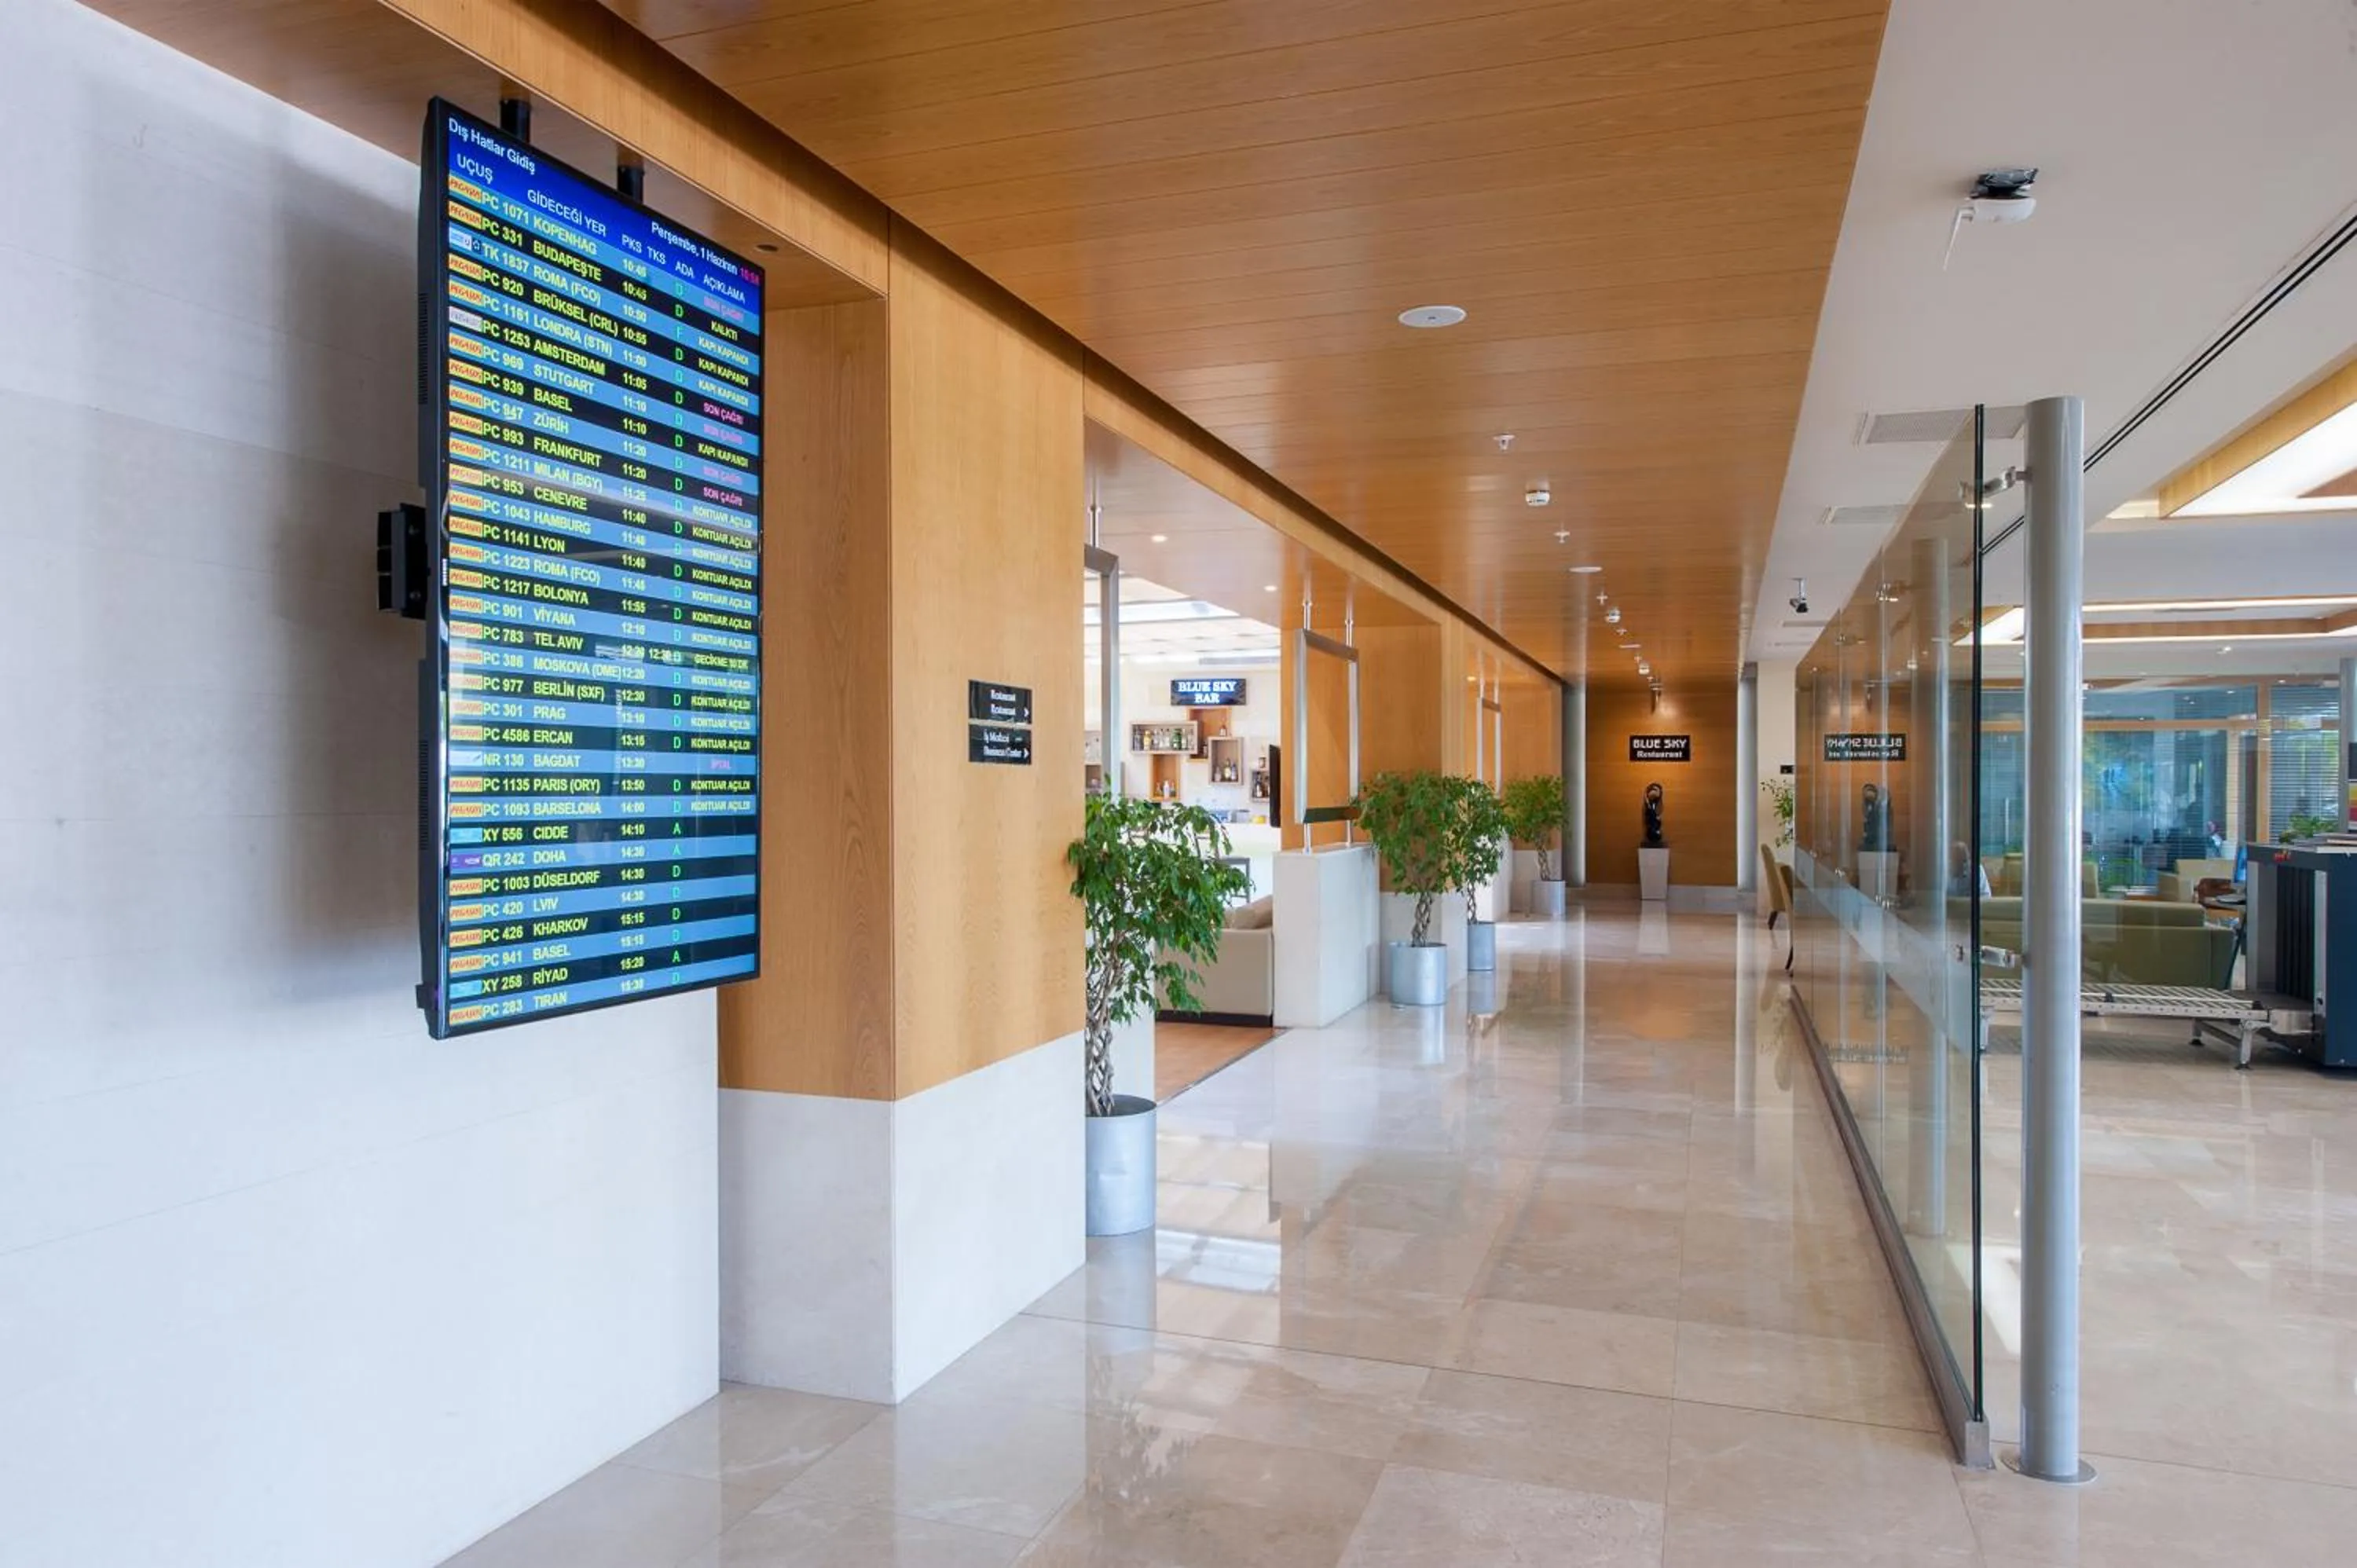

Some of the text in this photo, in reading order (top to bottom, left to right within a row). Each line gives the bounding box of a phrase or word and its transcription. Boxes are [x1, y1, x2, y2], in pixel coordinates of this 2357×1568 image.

[449, 117, 535, 177] Dış Hatlar Gidiş
[456, 152, 493, 185] UÇUŞ
[527, 185, 582, 226] GİDECEĞİ
[584, 214, 606, 237] YER
[621, 233, 642, 254] PKS
[647, 245, 666, 266] TKS
[675, 258, 694, 279] ADA
[703, 272, 745, 306] AÇIKLAMA
[482, 190, 499, 211] PC
[533, 214, 596, 255] KOPENHAG
[482, 216, 498, 236] PC
[502, 225, 522, 246] 331
[533, 239, 601, 283] BUDAPEŞTE
[482, 242, 498, 262] TK
[533, 264, 567, 291] ROMA
[706, 248, 738, 277] Haziran
[483, 268, 498, 287] PC
[502, 276, 523, 297] 920
[533, 285, 587, 322] BRÜKSEL
[589, 311, 618, 336] (CRL)
[483, 294, 498, 312] PC
[533, 313, 581, 343] LONDRA
[483, 319, 500, 338] PC
[504, 327, 530, 349] 1253
[533, 338, 604, 376] AMSTERDAM
[622, 371, 646, 390] 11:05
[484, 345, 500, 363] PC
[533, 362, 593, 394] STUTGART
[484, 371, 646, 435] PC 939 BASEL 11:10
[484, 396, 500, 413] PC
[484, 421, 500, 438] PC
[503, 427, 523, 445] 993
[534, 436, 601, 467] FRANKFURT
[622, 462, 646, 479] 11:20
[484, 447, 500, 463] PC
[504, 452, 529, 471] 1211
[483, 498, 500, 515] PC
[484, 472, 500, 489] PC
[533, 485, 587, 510] CENEVRE
[622, 507, 646, 524] 11:40
[483, 524, 564, 552] PC 1141 LYON
[483, 549, 499, 565] PC
[533, 559, 567, 577] ROMA
[483, 575, 499, 590] PC
[503, 578, 530, 595] 1217
[533, 583, 588, 604] BOLONYA
[483, 600, 499, 615] PC
[483, 625, 583, 650] PC 783 TEL AVIV
[483, 651, 499, 665] PC
[533, 657, 589, 674] MOSKOVA
[483, 676, 499, 691] PC
[503, 678, 523, 692] 977
[533, 678, 574, 696] BERLİN
[577, 684, 604, 701] (SXF)
[1178, 681, 1237, 691] BLUE SKY
[1194, 693, 1219, 703] BAR
[483, 702, 499, 716] PC
[533, 705, 566, 720] PRAG
[483, 727, 499, 740] PC
[533, 729, 572, 743] ERCAN
[1633, 738, 1688, 749] BLUE SKY
[483, 753, 500, 765] NR
[483, 778, 499, 790] PC
[503, 778, 530, 790] 1135
[570, 779, 600, 793] (ORY)
[483, 803, 499, 815] PC
[482, 828, 498, 841] XY
[621, 824, 644, 836] 14:10
[482, 853, 500, 868] QR
[533, 850, 566, 863] DOHA
[483, 877, 499, 892] PC
[503, 875, 530, 889] 1003
[533, 867, 600, 888] DÜSELDORF
[483, 903, 499, 917] PC
[503, 901, 523, 915] 420
[483, 928, 499, 942] PC
[533, 918, 588, 936] KHARKOV
[483, 953, 499, 967] PC
[533, 943, 570, 961] BASEL
[482, 978, 498, 993] XY
[483, 1003, 499, 1018] PC
